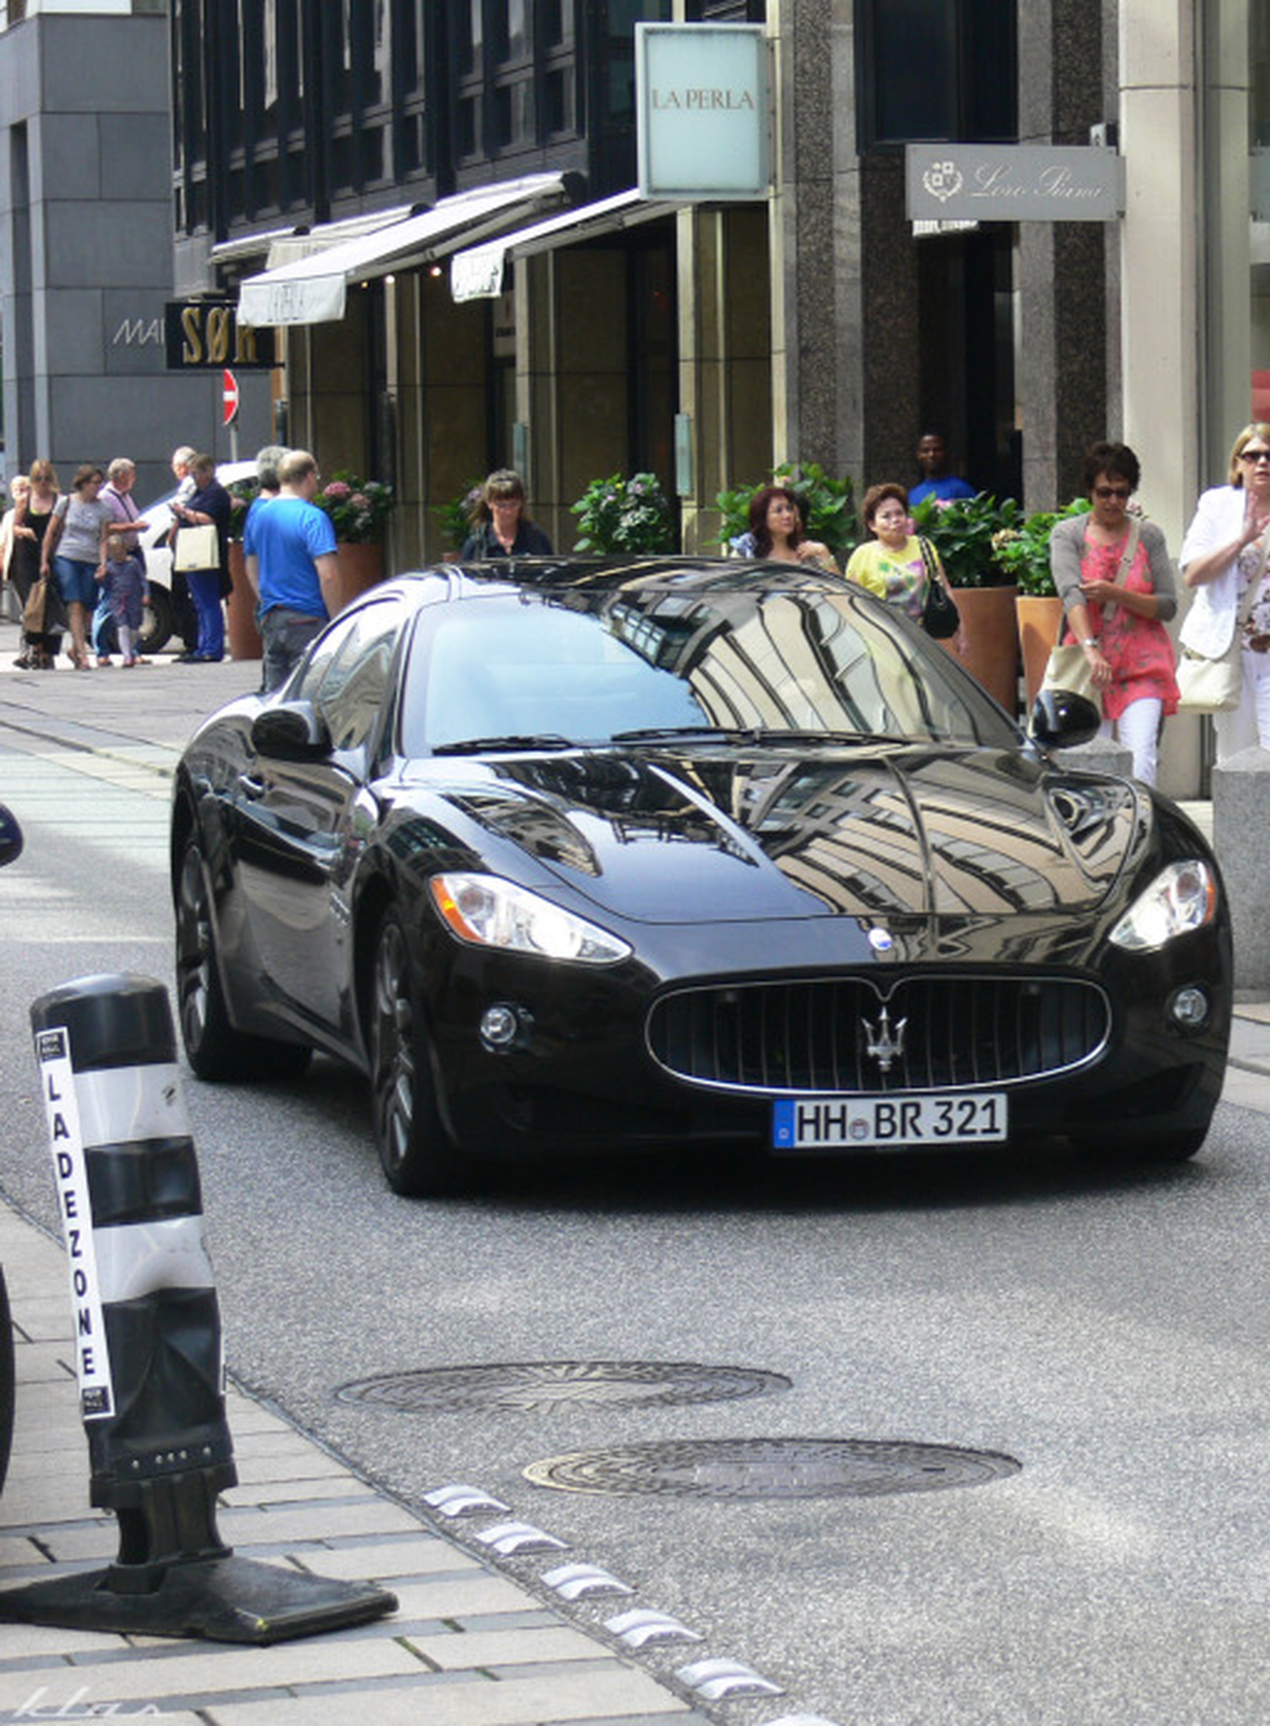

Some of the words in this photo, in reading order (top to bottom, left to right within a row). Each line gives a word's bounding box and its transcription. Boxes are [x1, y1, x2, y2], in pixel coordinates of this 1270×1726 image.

[652, 89, 681, 109] LA
[686, 88, 755, 109] PERLA
[970, 163, 1027, 198] Loro
[1034, 164, 1103, 198] Piana
[113, 317, 166, 345] MA
[797, 1104, 847, 1141] HH
[874, 1102, 923, 1139] BR
[932, 1098, 1001, 1136] 321
[48, 1073, 95, 1375] LADEZONE
